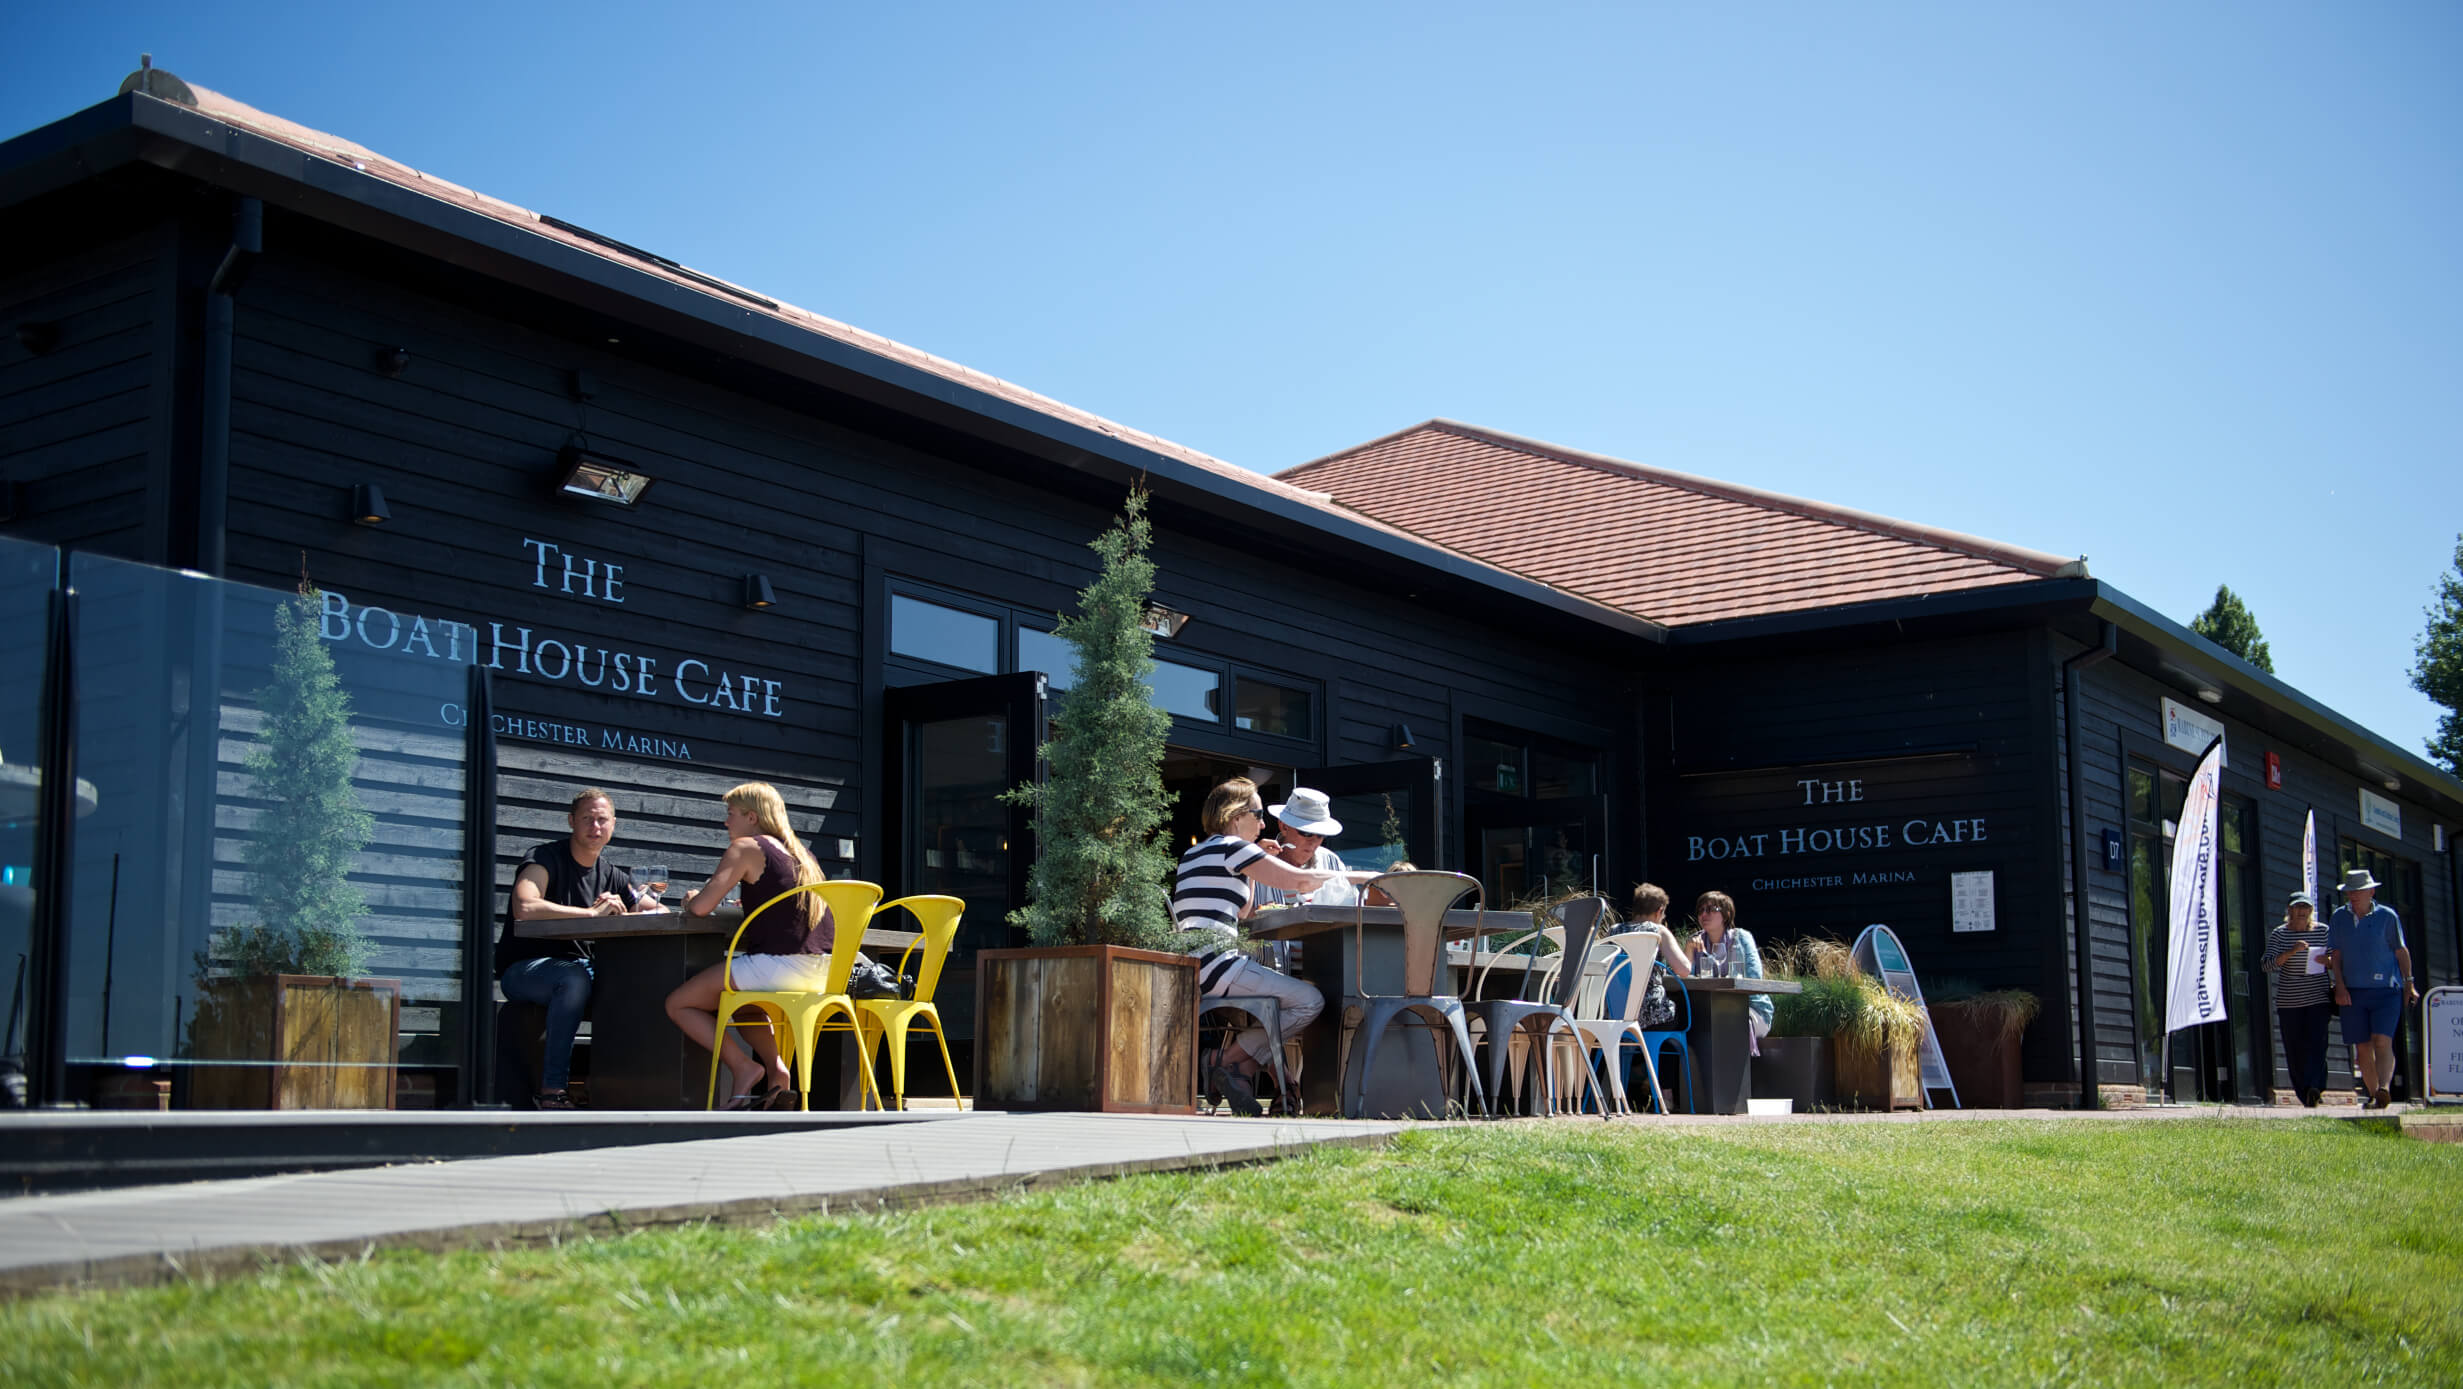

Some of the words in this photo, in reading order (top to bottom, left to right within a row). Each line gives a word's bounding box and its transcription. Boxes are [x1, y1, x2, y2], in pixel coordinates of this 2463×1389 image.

[523, 537, 626, 604] THE
[318, 589, 473, 662] BOAT
[488, 621, 658, 697] HOUSE
[674, 658, 783, 718] CAFE
[440, 703, 592, 746] CCHESTER
[601, 729, 692, 761] MARINA
[1797, 778, 1864, 805] THE
[1687, 834, 1769, 861] BOAT
[1778, 825, 1892, 855] HOUSE
[1902, 818, 1988, 846] CAFE
[2110, 840, 2119, 860] D7
[1752, 873, 1843, 892] CHICHESTER
[1852, 870, 1916, 885] MARINA
